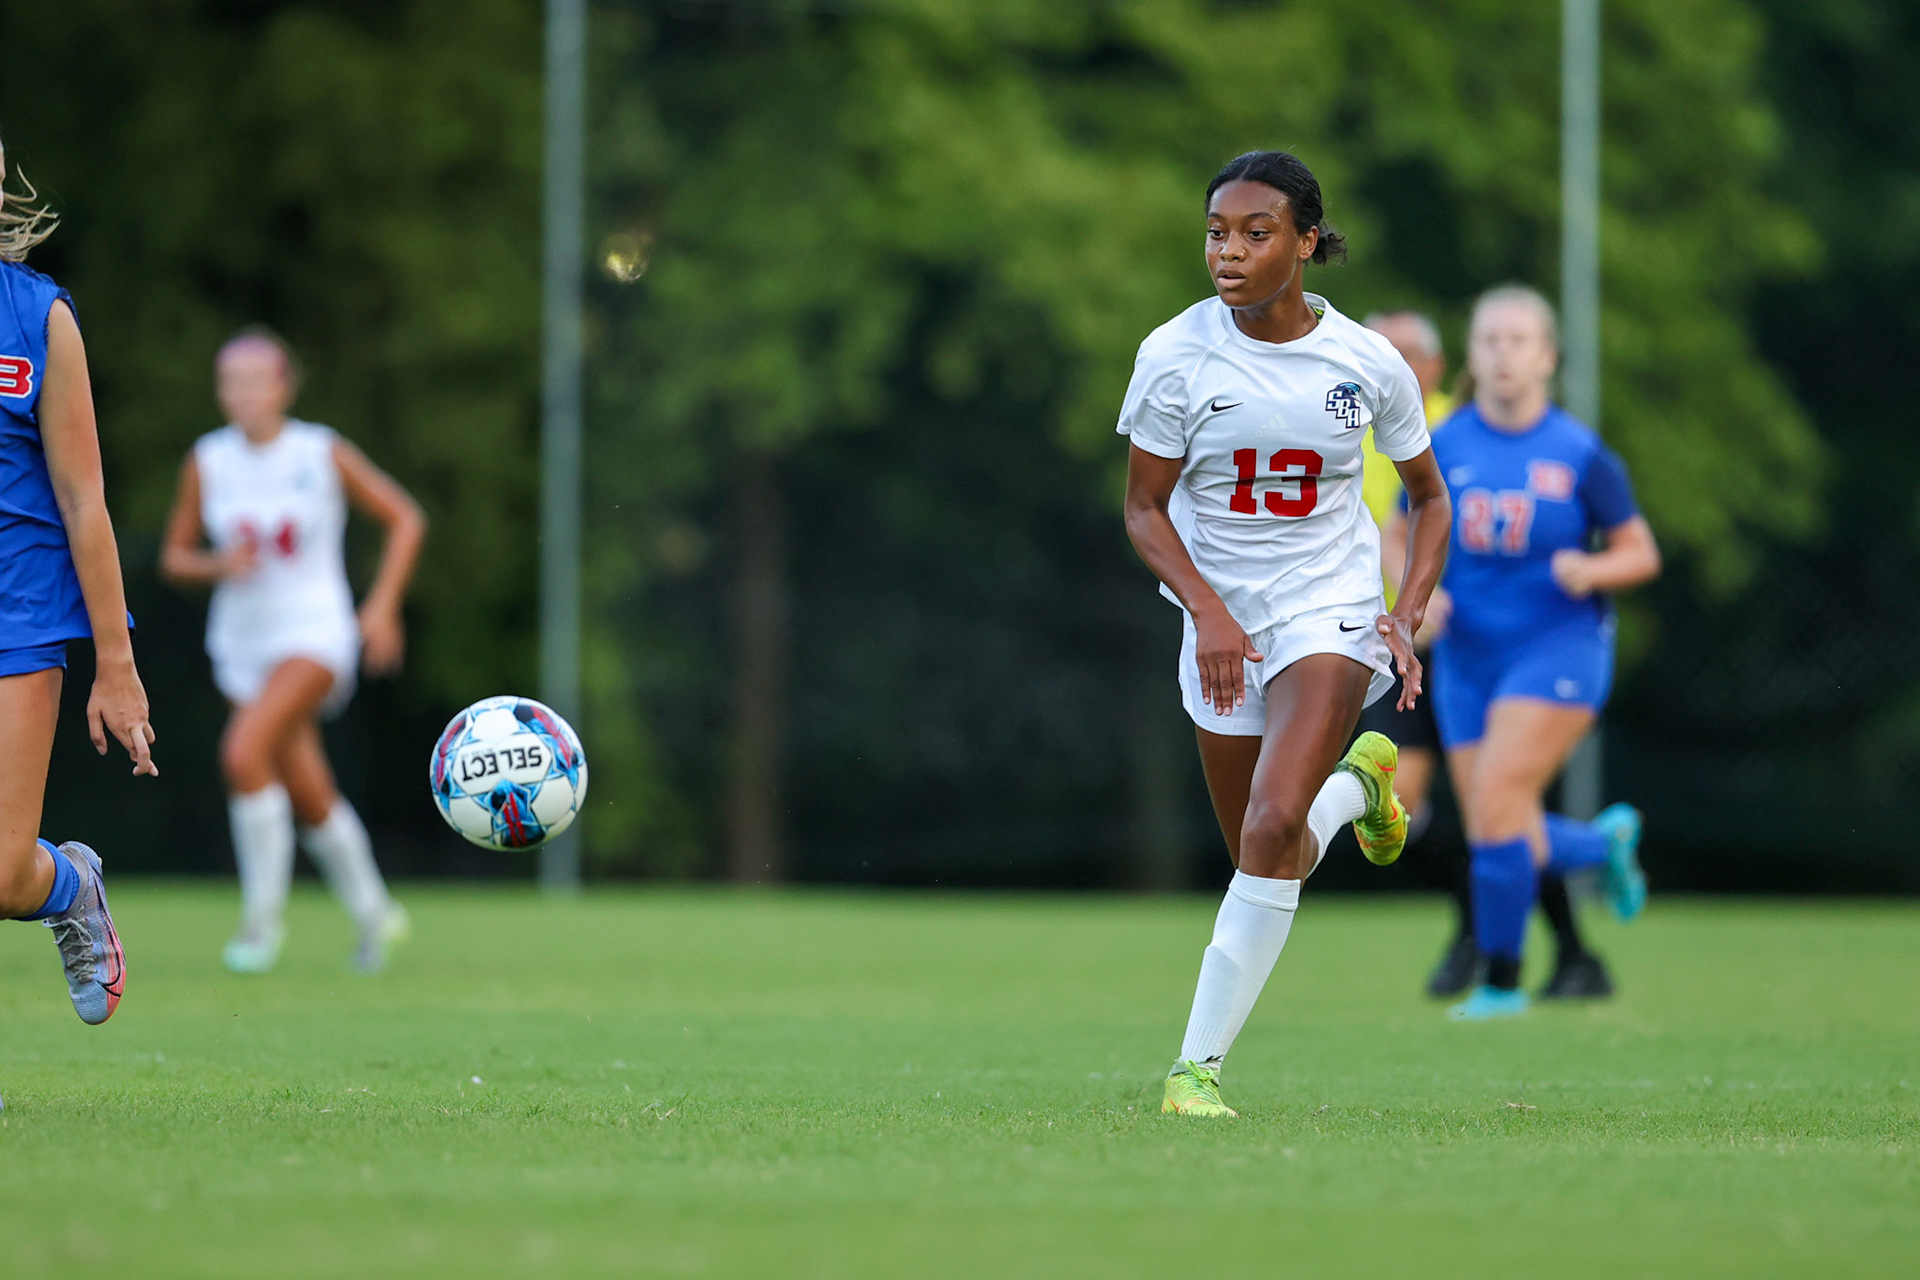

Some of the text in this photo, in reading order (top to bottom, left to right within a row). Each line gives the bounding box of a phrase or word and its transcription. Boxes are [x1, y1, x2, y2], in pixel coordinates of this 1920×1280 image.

[1325, 389, 1360, 429] SBA
[1229, 448, 1324, 518] 13
[1458, 487, 1536, 557] 27
[461, 746, 543, 782] SELECT
